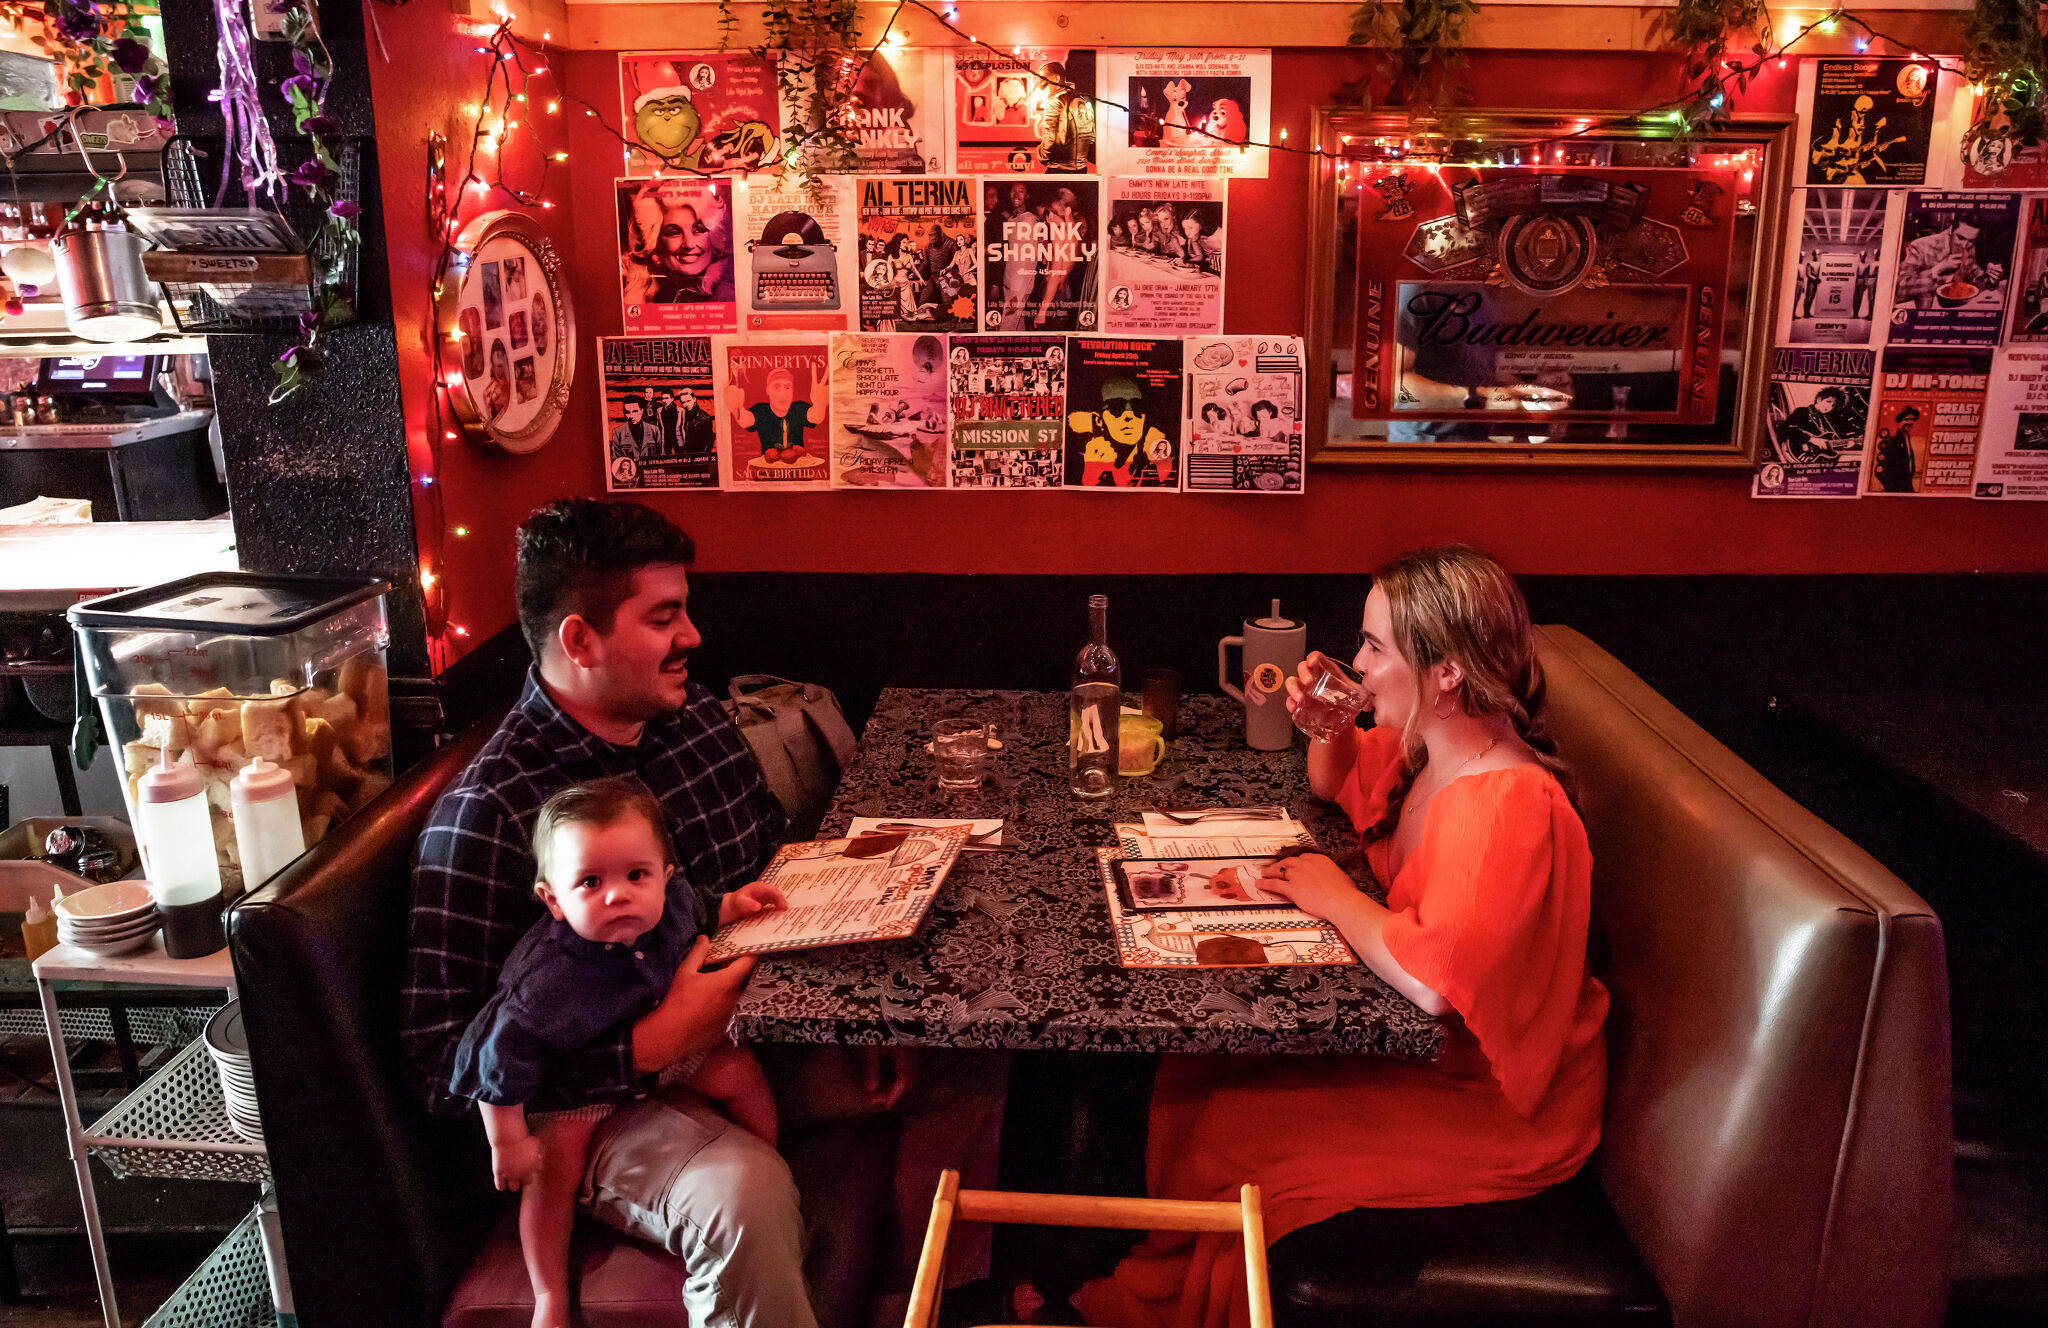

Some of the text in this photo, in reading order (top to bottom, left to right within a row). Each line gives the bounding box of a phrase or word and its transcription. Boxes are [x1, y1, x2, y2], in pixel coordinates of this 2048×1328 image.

[1134, 52, 1162, 62] Friday
[1165, 52, 1184, 62] May
[956, 62, 1031, 70] 45 EXPLOSION
[958, 160, 972, 169] all
[975, 160, 988, 169] on
[1129, 180, 1205, 188] EMMY'S NEW LATE NITE
[864, 181, 970, 206] ALTERNA
[1121, 191, 1180, 199] DJ HOURS FRIDAYS
[752, 205, 834, 213] HAPPY HOUR
[1003, 222, 1082, 240] FRANK
[987, 243, 1097, 261] SHANKLY
[199, 258, 249, 268] SWEETS
[1829, 295, 1840, 303] 15
[1408, 291, 1668, 347] Budweiser
[1078, 340, 1128, 350] "REVOLUTION
[1364, 280, 1384, 411] GENUINE
[1690, 286, 1713, 416] GENUINE
[607, 341, 708, 363] ALTERNA
[731, 355, 826, 369] SPINNERTY'S
[1774, 350, 1870, 373] ALTERNA
[1885, 373, 1907, 388] DJ
[1911, 374, 1986, 390] HI-TONE
[1936, 403, 1980, 414] GREASY
[963, 429, 1057, 443] MISSION ST
[1932, 431, 1977, 443] STOMPIN'
[1929, 444, 1975, 454] GARAGE
[840, 446, 882, 467] FRIDAY
[736, 468, 828, 479] SAUCY BIRTHDAY
